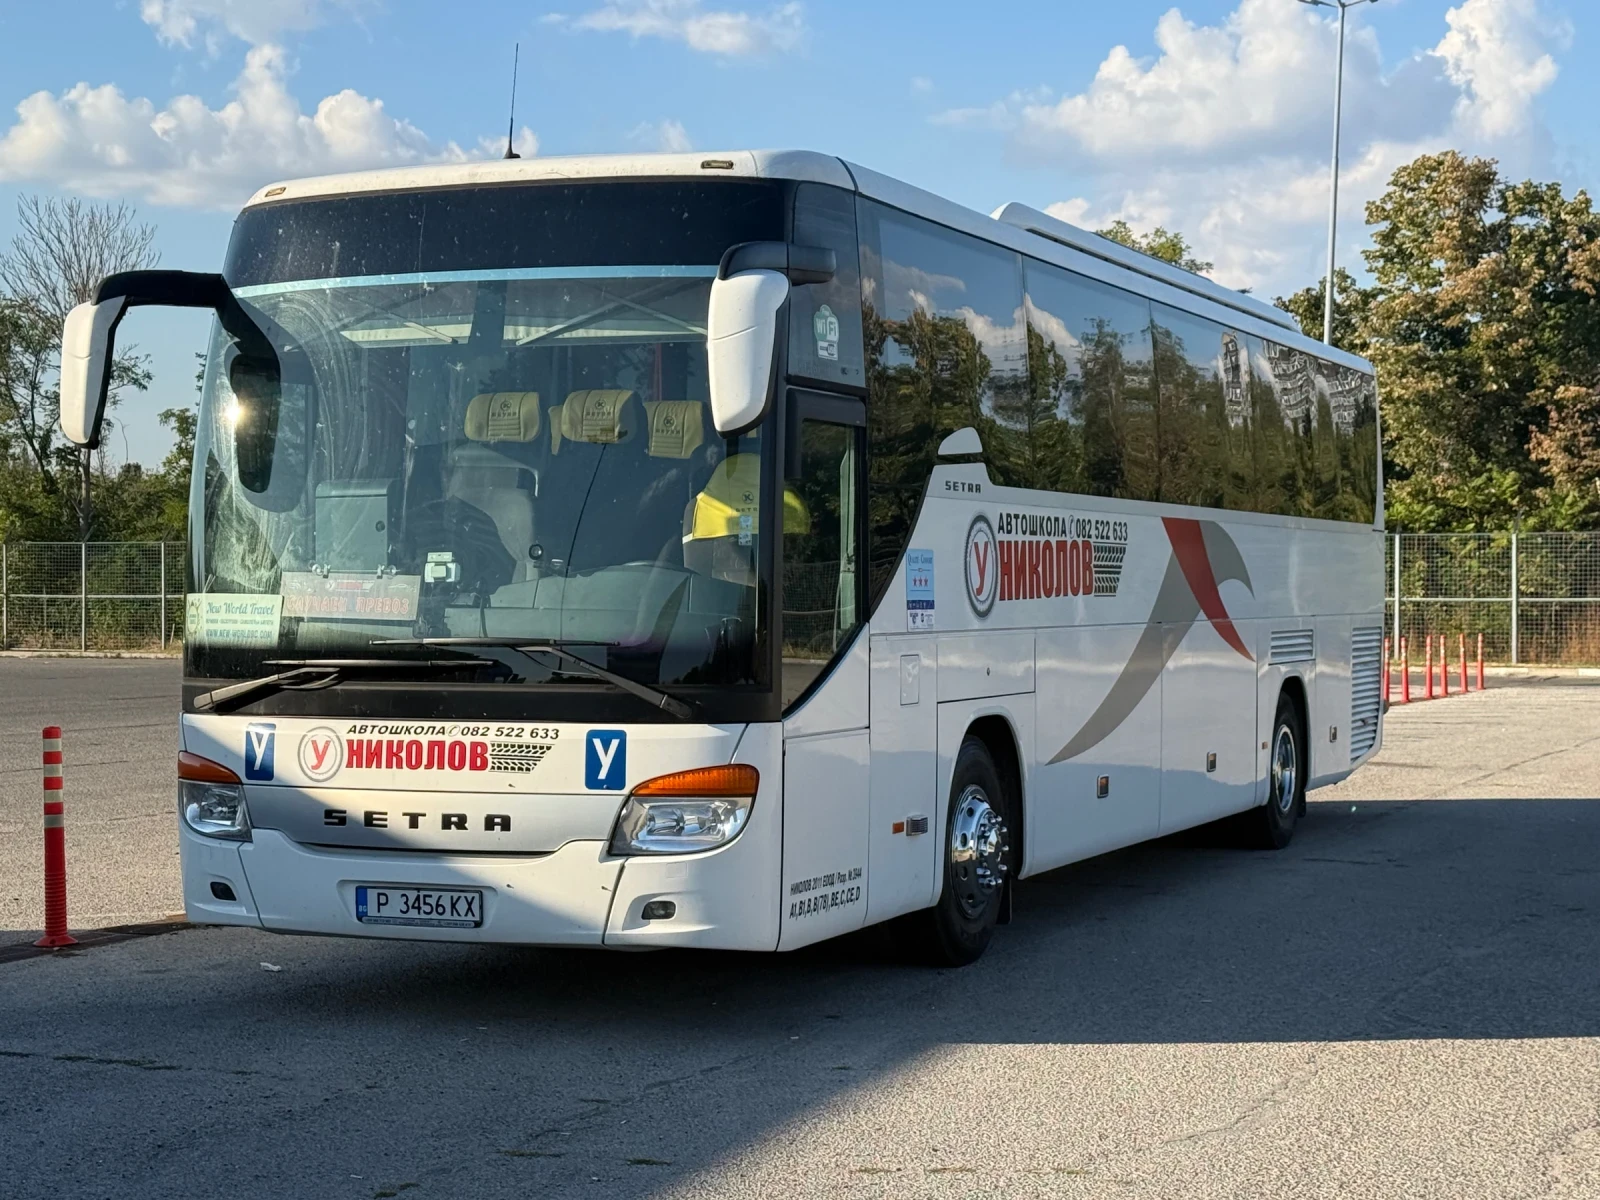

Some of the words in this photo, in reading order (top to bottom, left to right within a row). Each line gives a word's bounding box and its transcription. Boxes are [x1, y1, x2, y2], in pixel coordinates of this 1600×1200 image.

[945, 480, 982, 494] SETRA
[997, 512, 1067, 538] АВТОШКОЛА
[1075, 518, 1093, 539] 082
[1095, 520, 1111, 540] 522
[1112, 521, 1128, 542] 633
[997, 539, 1094, 602] НИКОЛОВ
[206, 602, 222, 614] New
[223, 602, 248, 615] World
[249, 603, 275, 616] Travel
[355, 596, 410, 615] ПРЕВОЗ
[346, 724, 446, 736] АВТОШКОЛА
[460, 725, 490, 738] 082
[495, 726, 525, 739] 522
[530, 727, 560, 740] 633
[345, 738, 489, 771] НИКОЛОВ
[323, 808, 512, 832] SETRA
